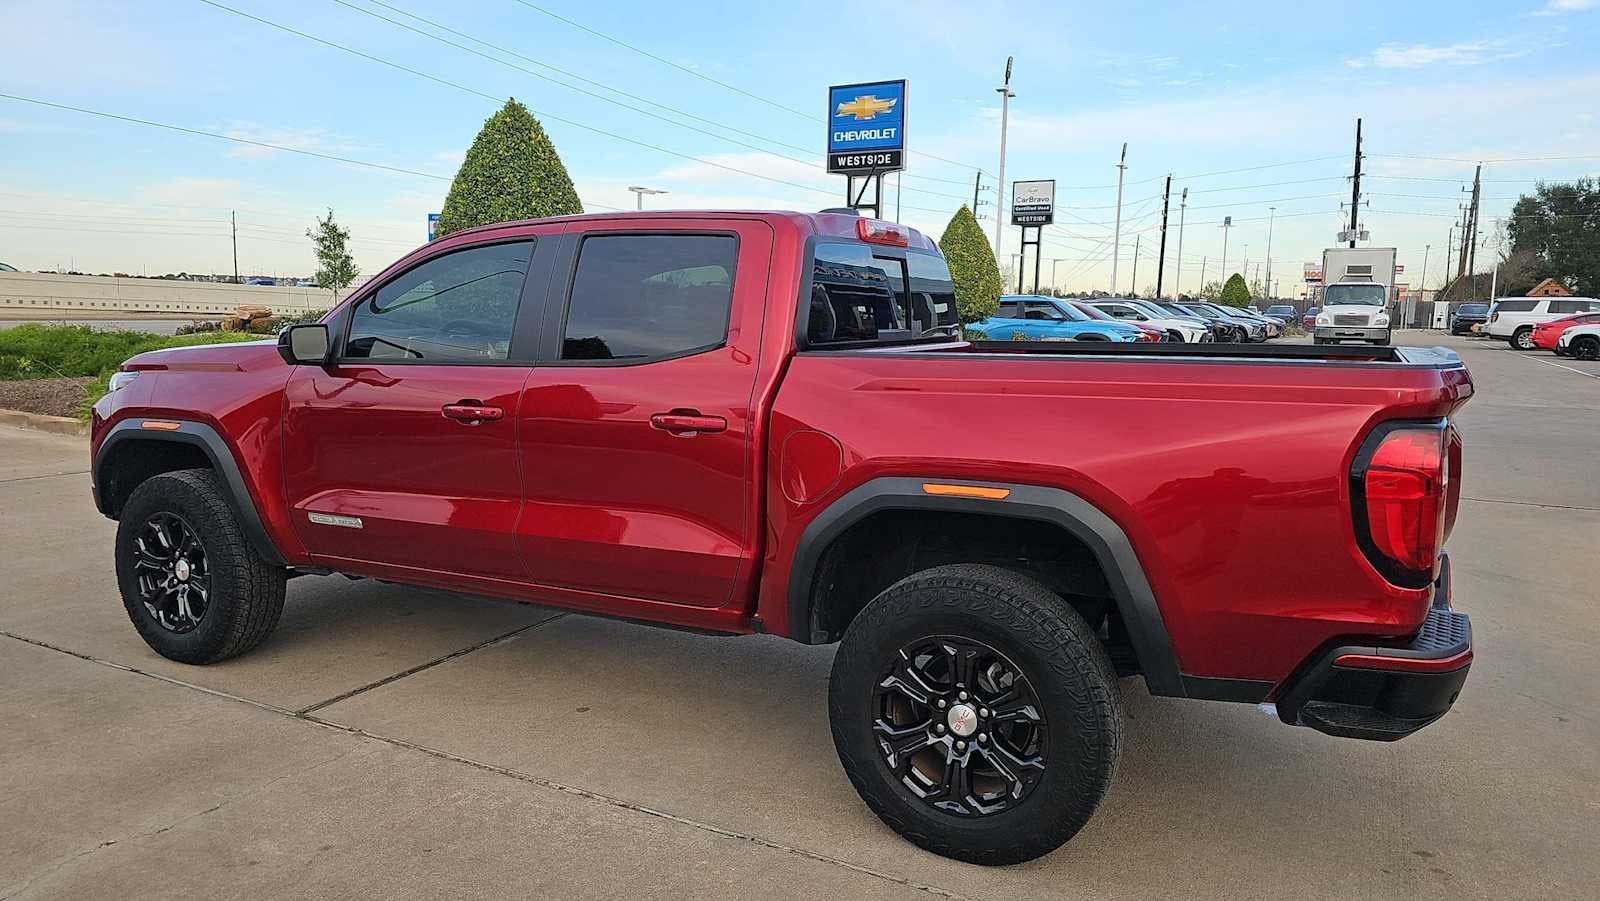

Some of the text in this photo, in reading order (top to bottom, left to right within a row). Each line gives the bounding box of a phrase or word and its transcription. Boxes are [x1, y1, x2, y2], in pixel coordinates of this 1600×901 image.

[833, 128, 897, 142] CHEVROLET
[837, 154, 892, 166] WESTSIDE
[954, 709, 971, 731] GMC
